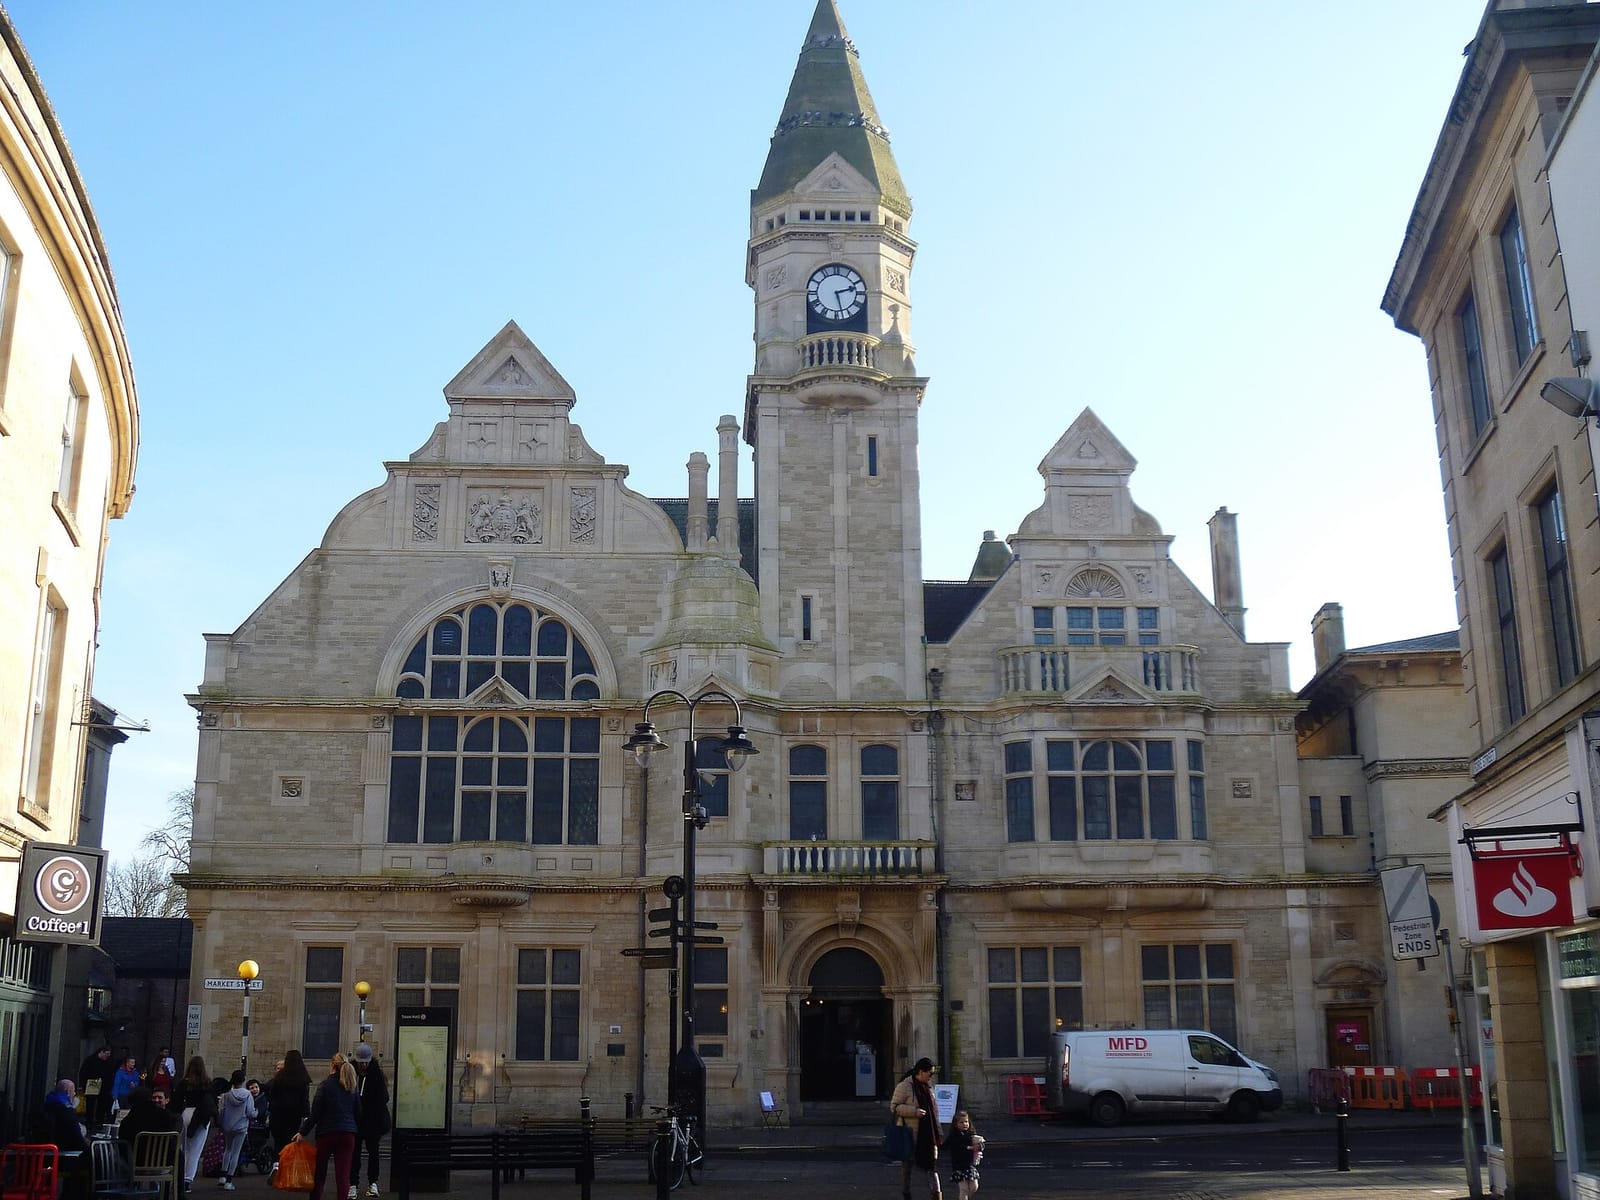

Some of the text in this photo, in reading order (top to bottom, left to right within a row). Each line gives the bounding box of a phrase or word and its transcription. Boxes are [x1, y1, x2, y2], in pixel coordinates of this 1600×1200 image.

[1393, 922, 1431, 932] Pedestrian
[1397, 940, 1431, 953] ENDS
[1108, 1037, 1148, 1050] MFD
